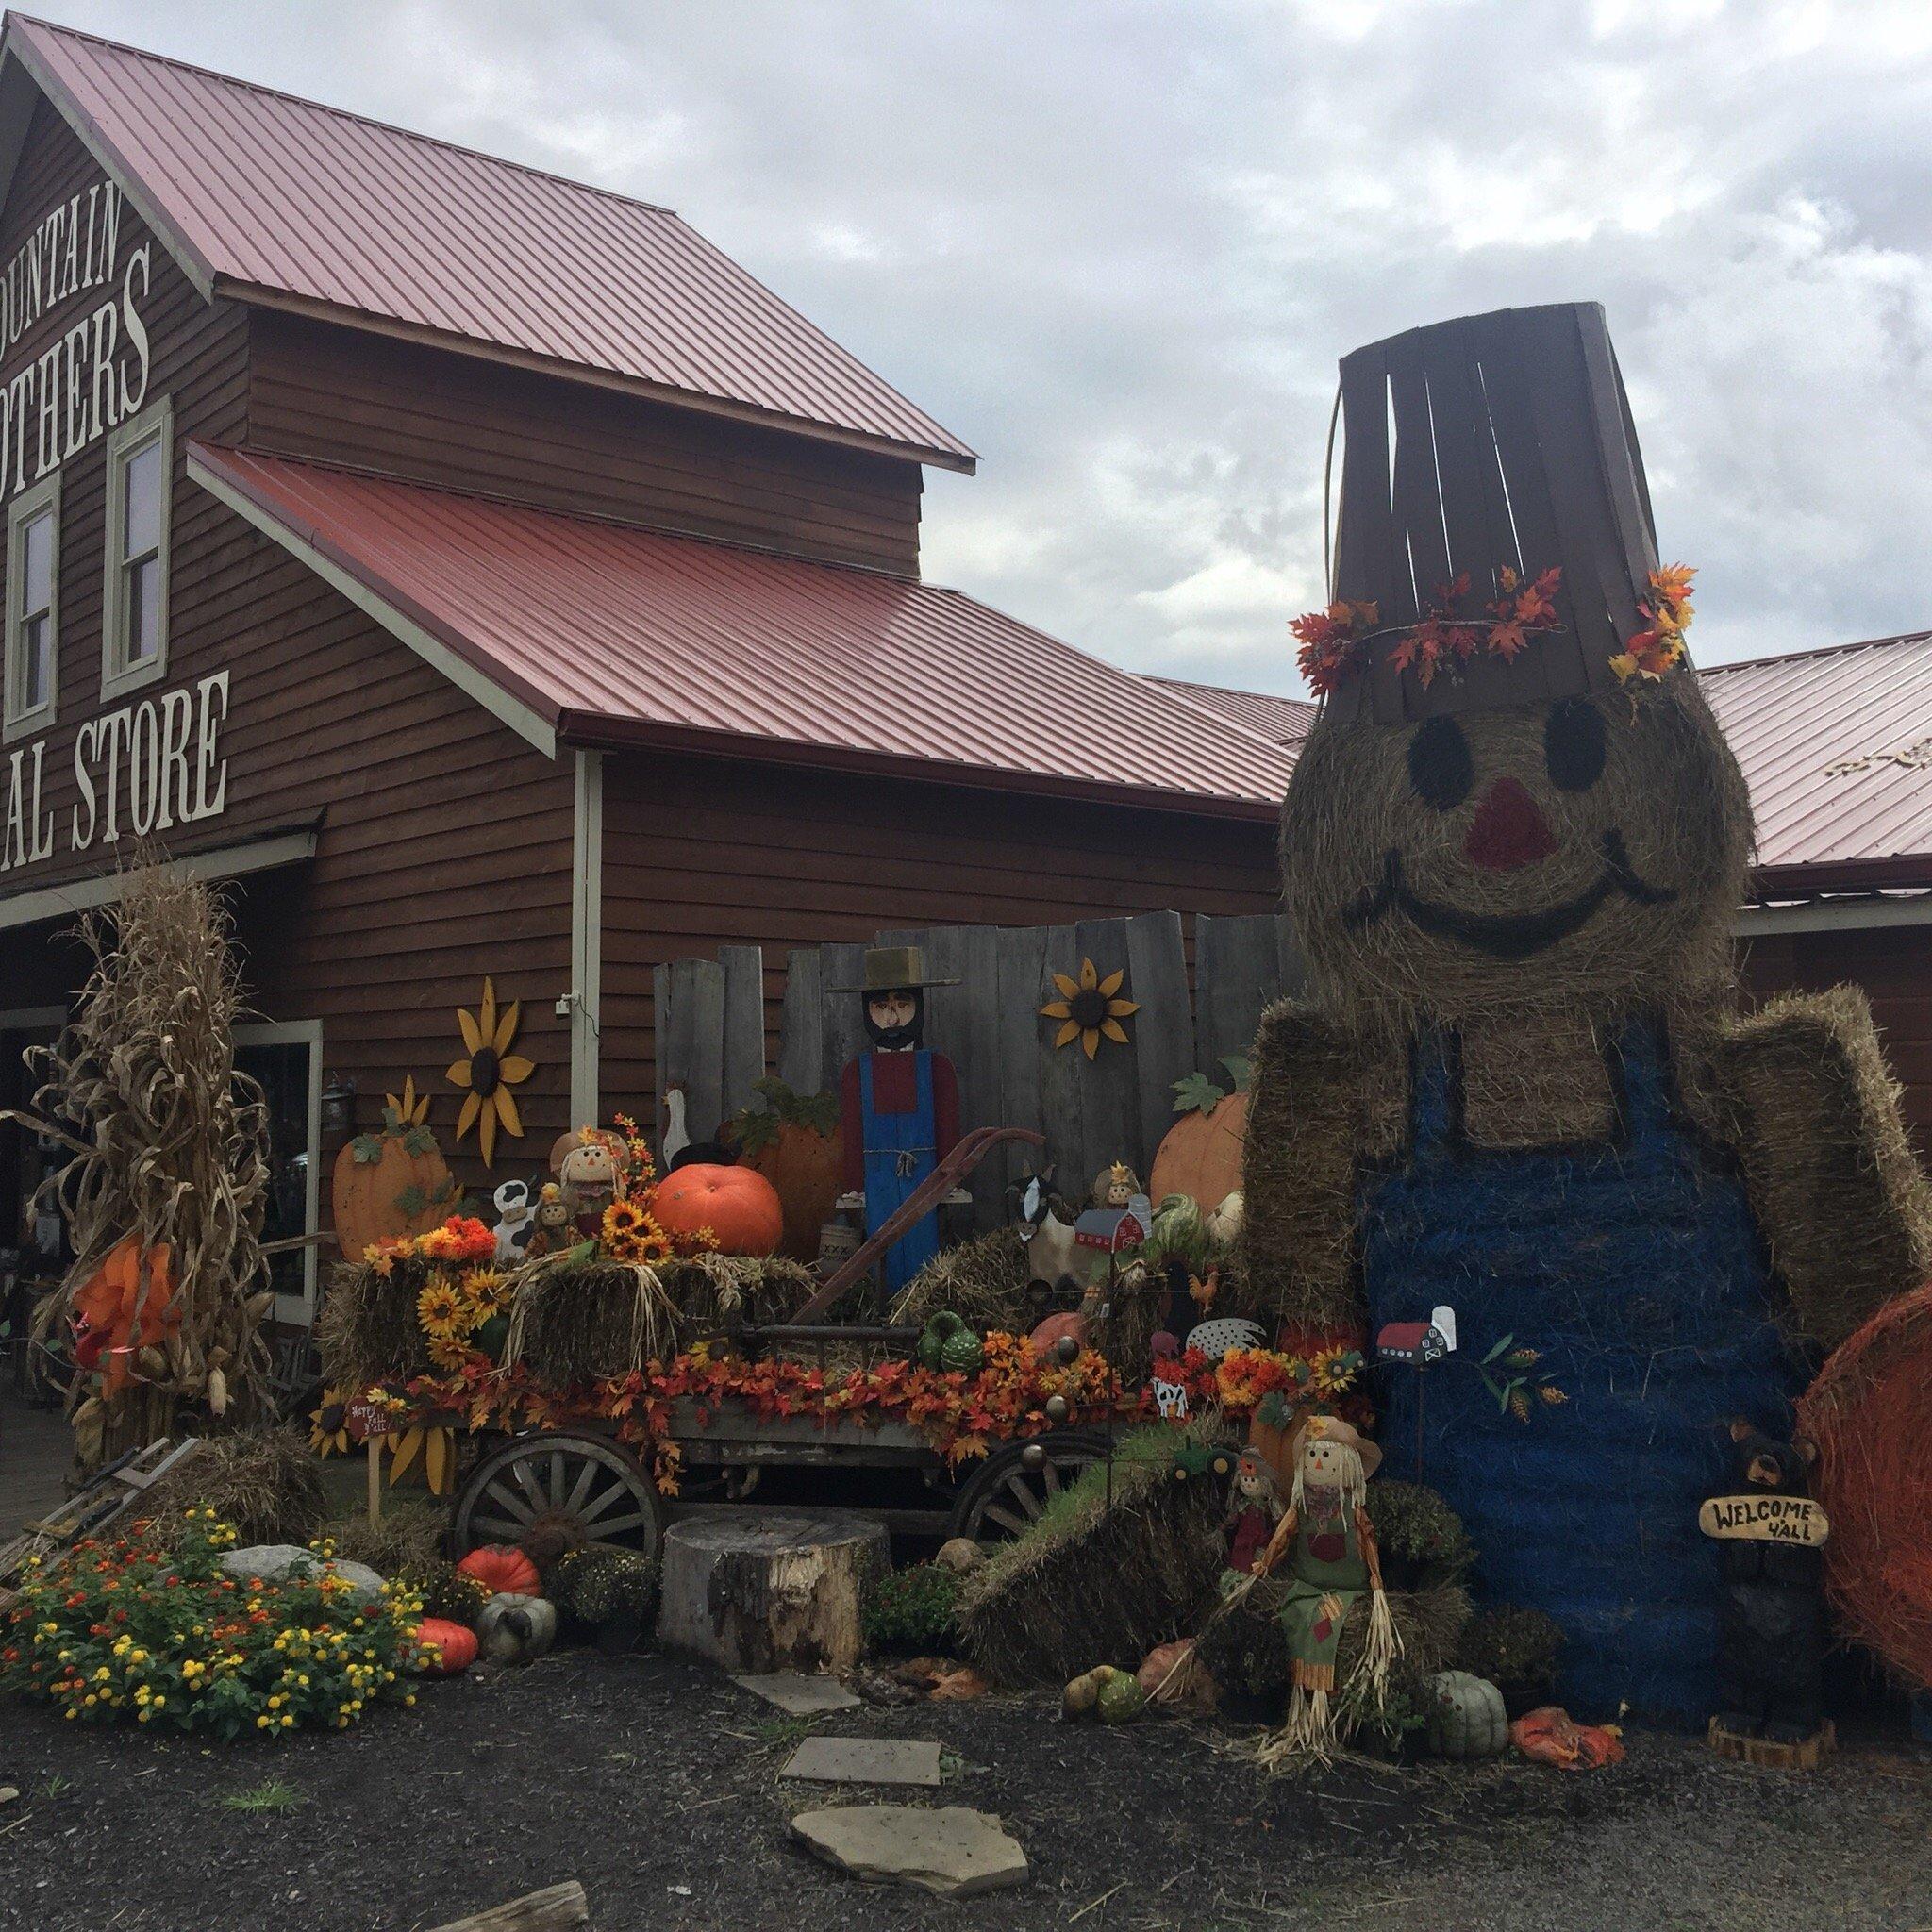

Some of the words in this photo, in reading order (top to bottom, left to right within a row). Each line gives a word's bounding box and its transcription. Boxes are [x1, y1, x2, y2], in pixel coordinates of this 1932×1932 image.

[0, 740, 54, 872] AL
[71, 669, 229, 851] STORE
[1712, 1500, 1813, 1530] WELCOME
[1768, 1519, 1811, 1541] Y'ALL
